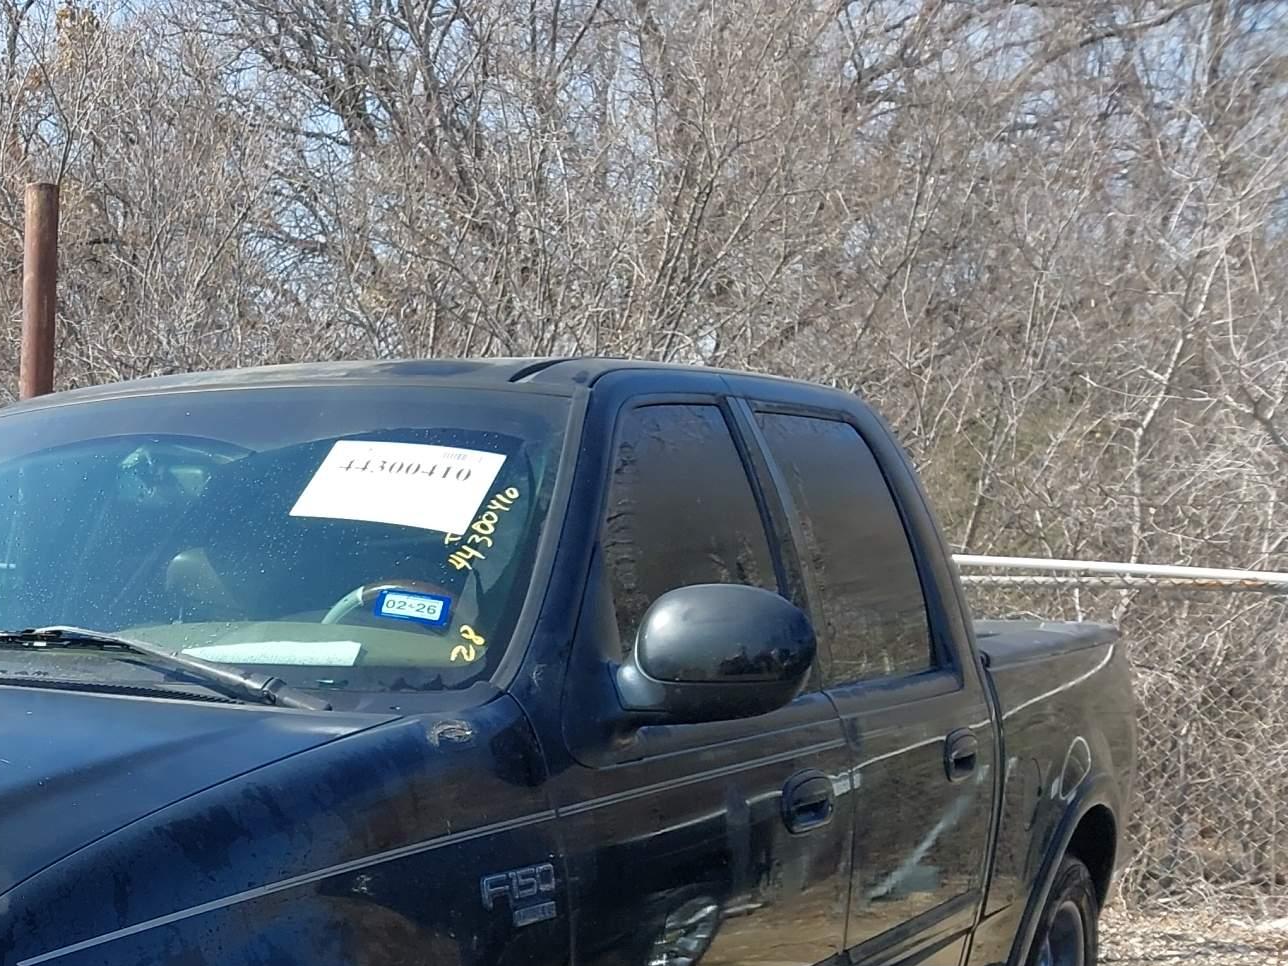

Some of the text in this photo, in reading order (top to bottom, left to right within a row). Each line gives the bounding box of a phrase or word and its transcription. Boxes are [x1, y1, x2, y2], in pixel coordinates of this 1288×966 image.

[338, 459, 472, 482] 44300410
[448, 487, 520, 571] 44300410
[385, 599, 438, 616] 02-26
[450, 624, 485, 662] 28
